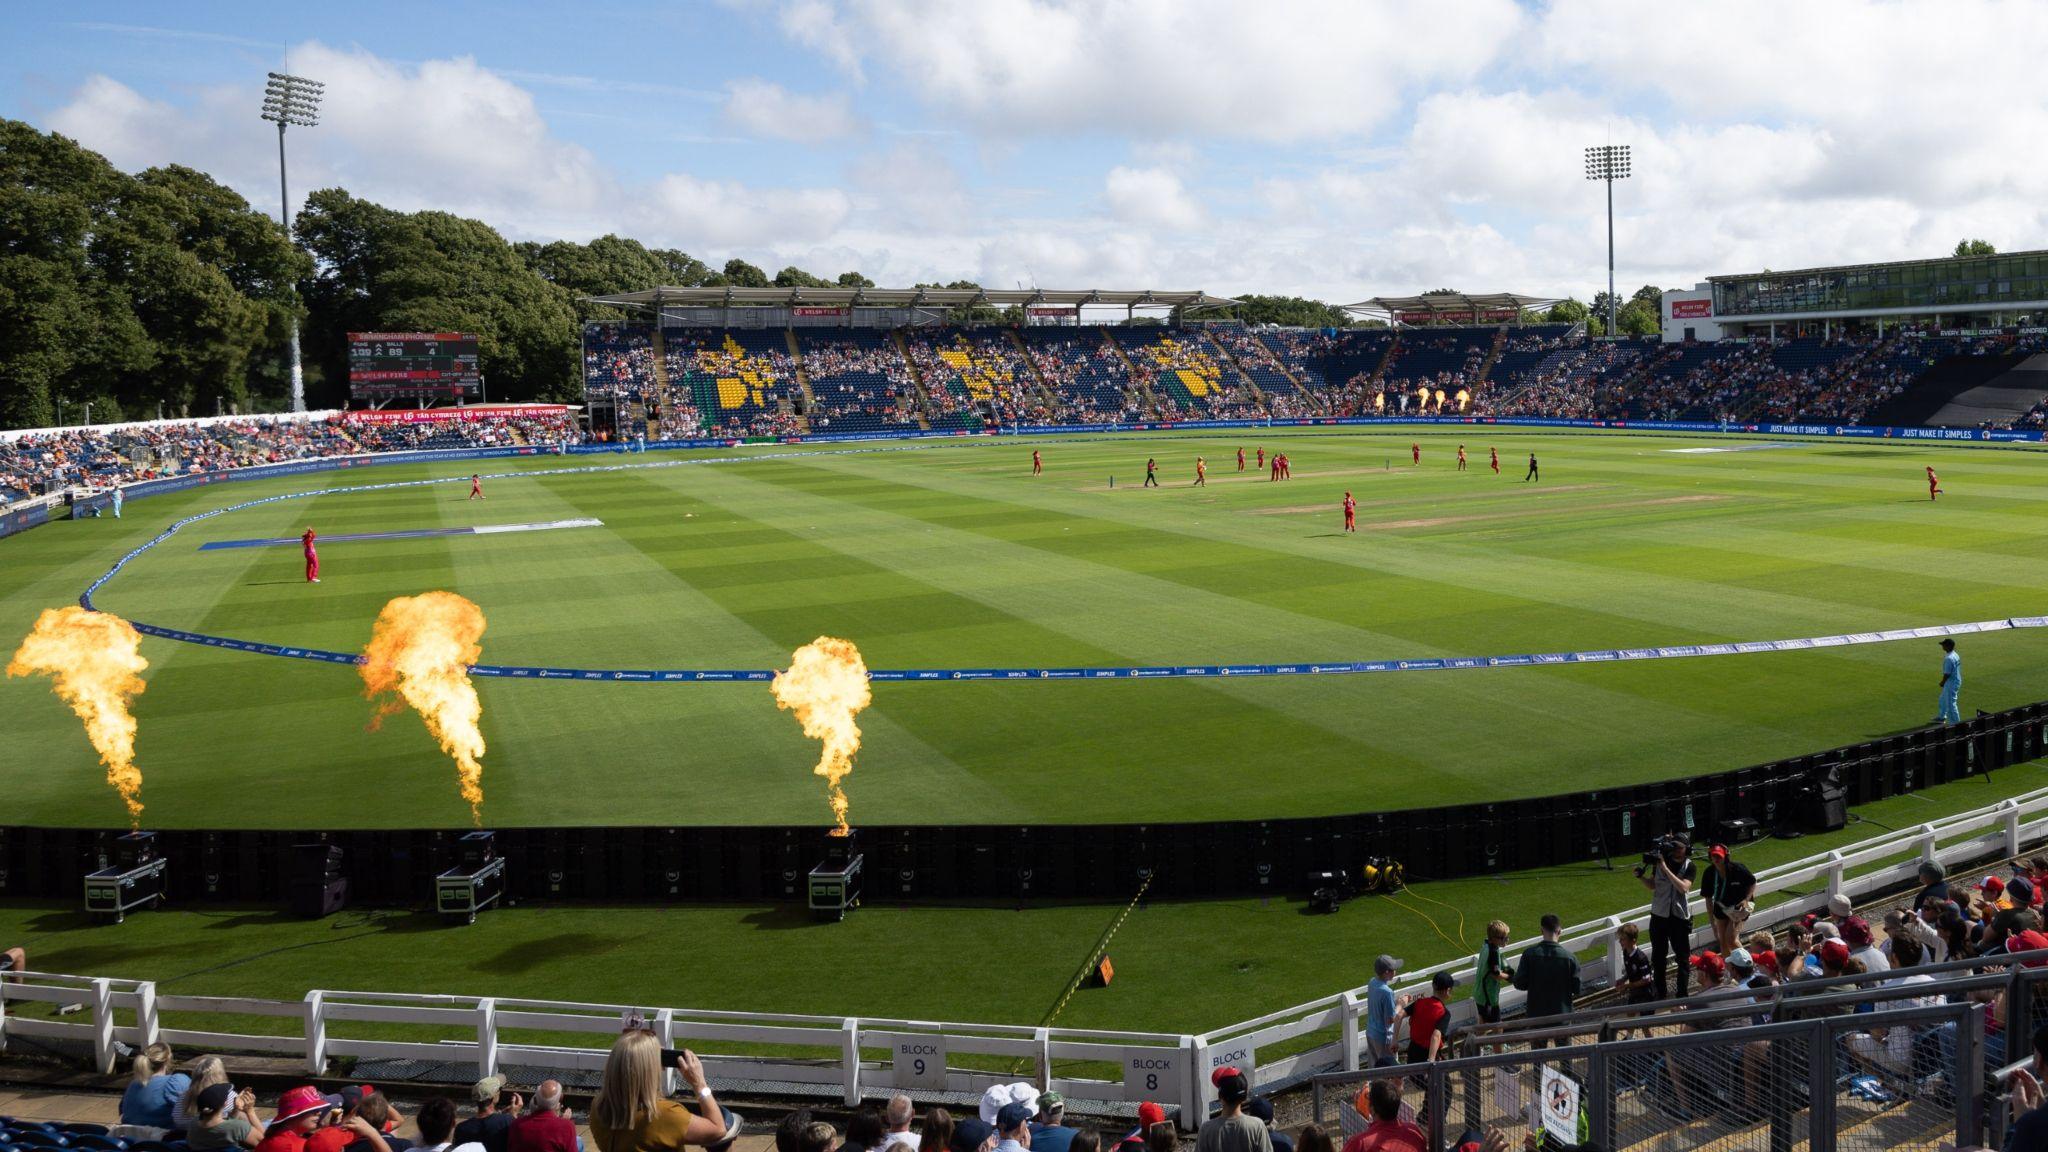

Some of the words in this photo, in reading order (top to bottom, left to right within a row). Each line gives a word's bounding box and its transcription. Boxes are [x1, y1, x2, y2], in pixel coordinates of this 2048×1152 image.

[1805, 426, 1828, 434] SIMPLES
[1938, 430, 1943, 438] IT
[1945, 430, 1972, 439] SIMPLES
[901, 1045, 937, 1056] BLOCK
[1213, 1049, 1247, 1067] BLOCK
[914, 1059, 925, 1075] 9
[1133, 1059, 1170, 1069] BLOCK
[1146, 1074, 1158, 1090] 8
